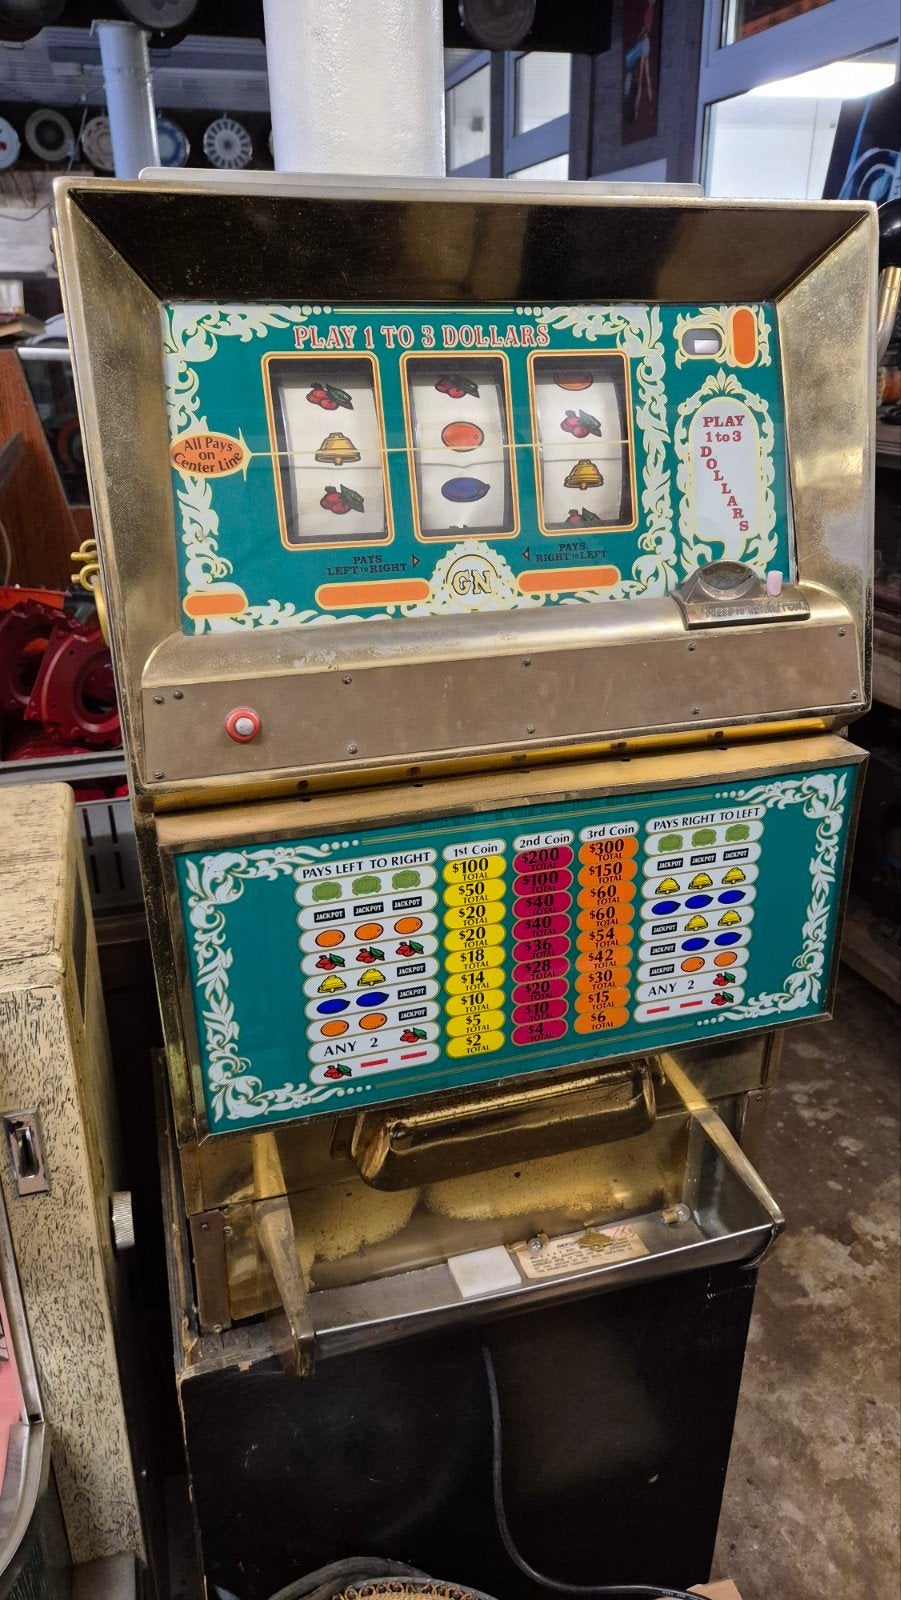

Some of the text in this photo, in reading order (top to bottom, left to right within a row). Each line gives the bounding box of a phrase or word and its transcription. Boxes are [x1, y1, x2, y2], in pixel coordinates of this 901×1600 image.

[293, 324, 550, 349] PLAY 1 TO 3 DOLLARS
[702, 415, 745, 427] PLAY
[706, 431, 742, 442] 1 to 3
[184, 437, 234, 452] All Pays
[199, 452, 215, 460] on
[174, 453, 242, 472] Center Line
[700, 446, 749, 531] DOLLARS
[559, 542, 586, 552] PAYS
[353, 555, 382, 564] PAYS
[536, 552, 571, 562] RIGHT
[580, 550, 607, 559] LEFT
[326, 566, 358, 575] LEFT
[370, 563, 407, 574] RIGHT
[451, 570, 492, 595] GN
[654, 808, 760, 830] PAYS RIGHT TO LEFT
[587, 825, 634, 839] 3rd Coin
[520, 834, 569, 848] 2nd Coin
[453, 844, 497, 857] 1st Coin
[589, 839, 624, 855] $300
[522, 847, 559, 864] $200
[598, 853, 622, 861] TOTAL
[692, 855, 715, 864] JACKPOT
[724, 850, 748, 859] JACKPOT
[302, 852, 430, 878] PAYS LEFT TO RIGHT
[453, 858, 488, 873] $100
[532, 862, 556, 871] TOTAL
[589, 862, 622, 877] $150
[659, 860, 682, 868] JACKPOT
[463, 872, 488, 880] TOTAL
[523, 871, 558, 886] $100
[598, 875, 622, 884] TOTAL
[459, 882, 484, 896] $50
[532, 885, 555, 894] TOTAL
[590, 885, 616, 898] $60
[394, 899, 420, 908] JACKPOT
[463, 895, 489, 903] TOTAL
[526, 894, 554, 908] $40
[596, 897, 621, 905] TOTAL
[356, 904, 382, 914] JACKPOT
[459, 905, 485, 919] $20
[589, 906, 615, 920] $60
[316, 910, 344, 920] JACKPOT
[463, 917, 487, 926] TOTAL
[525, 916, 551, 930] $40
[596, 918, 619, 927] TOTAL
[459, 927, 485, 941] $20
[589, 927, 614, 941] $54
[654, 924, 676, 933] JACKPOT
[464, 940, 488, 948] TOTAL
[526, 938, 551, 951] $36
[595, 940, 619, 948] TOTAL
[652, 945, 674, 954] JACKPOT
[461, 949, 484, 962] $18
[588, 949, 613, 962] $42
[399, 965, 424, 976] JACKPOT
[464, 961, 489, 970] TOTAL
[525, 959, 550, 973] $28
[594, 961, 617, 969] TOTAL
[651, 966, 673, 975] JACKPOT
[461, 971, 484, 984] $14
[532, 971, 556, 980] TOTAL
[588, 970, 612, 983] $30
[466, 983, 489, 991] TOTAL
[525, 981, 550, 994] $20
[592, 982, 616, 990] TOTAL
[648, 979, 695, 997] ANY 2
[399, 987, 425, 998] JACKPOT
[530, 993, 553, 1001] TOTAL
[588, 990, 609, 1003] $15
[461, 993, 484, 1005] $10
[465, 1004, 489, 1012] TOTAL
[526, 1002, 548, 1014] $10
[592, 1002, 614, 1010] TOTAL
[400, 1008, 426, 1020] JACKPOT
[529, 1013, 552, 1021] TOTAL
[591, 1011, 606, 1023] $6
[466, 1014, 480, 1026] $5
[466, 1025, 489, 1033] TOTAL
[529, 1023, 544, 1034] $4
[592, 1022, 614, 1030] TOTAL
[466, 1035, 481, 1046] $2
[530, 1033, 553, 1042] TOTAL
[323, 1037, 378, 1057] ANY 2
[467, 1045, 489, 1053] TOTAL
